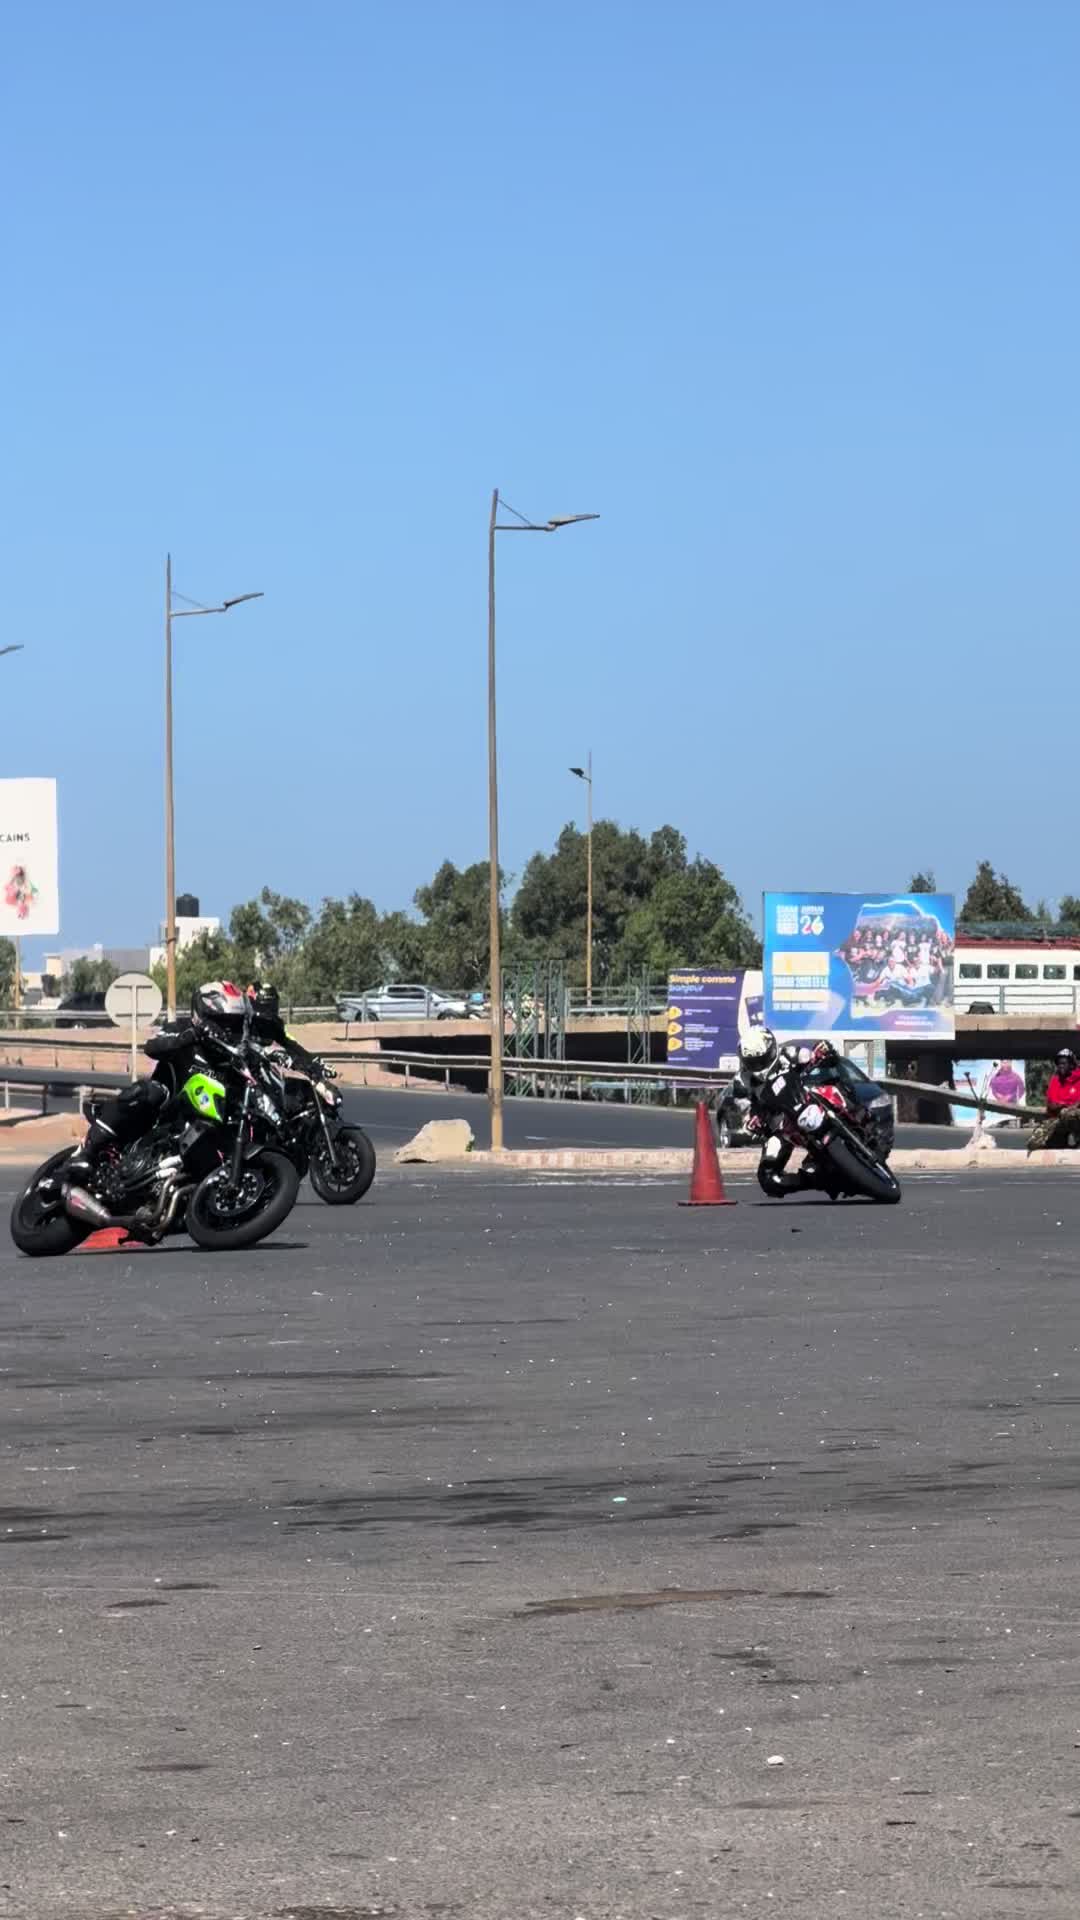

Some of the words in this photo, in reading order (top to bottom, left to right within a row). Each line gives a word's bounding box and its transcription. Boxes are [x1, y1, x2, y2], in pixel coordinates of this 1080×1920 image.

[800, 915, 824, 936] 26
[669, 974, 700, 984] Simple
[702, 976, 737, 984] comme
